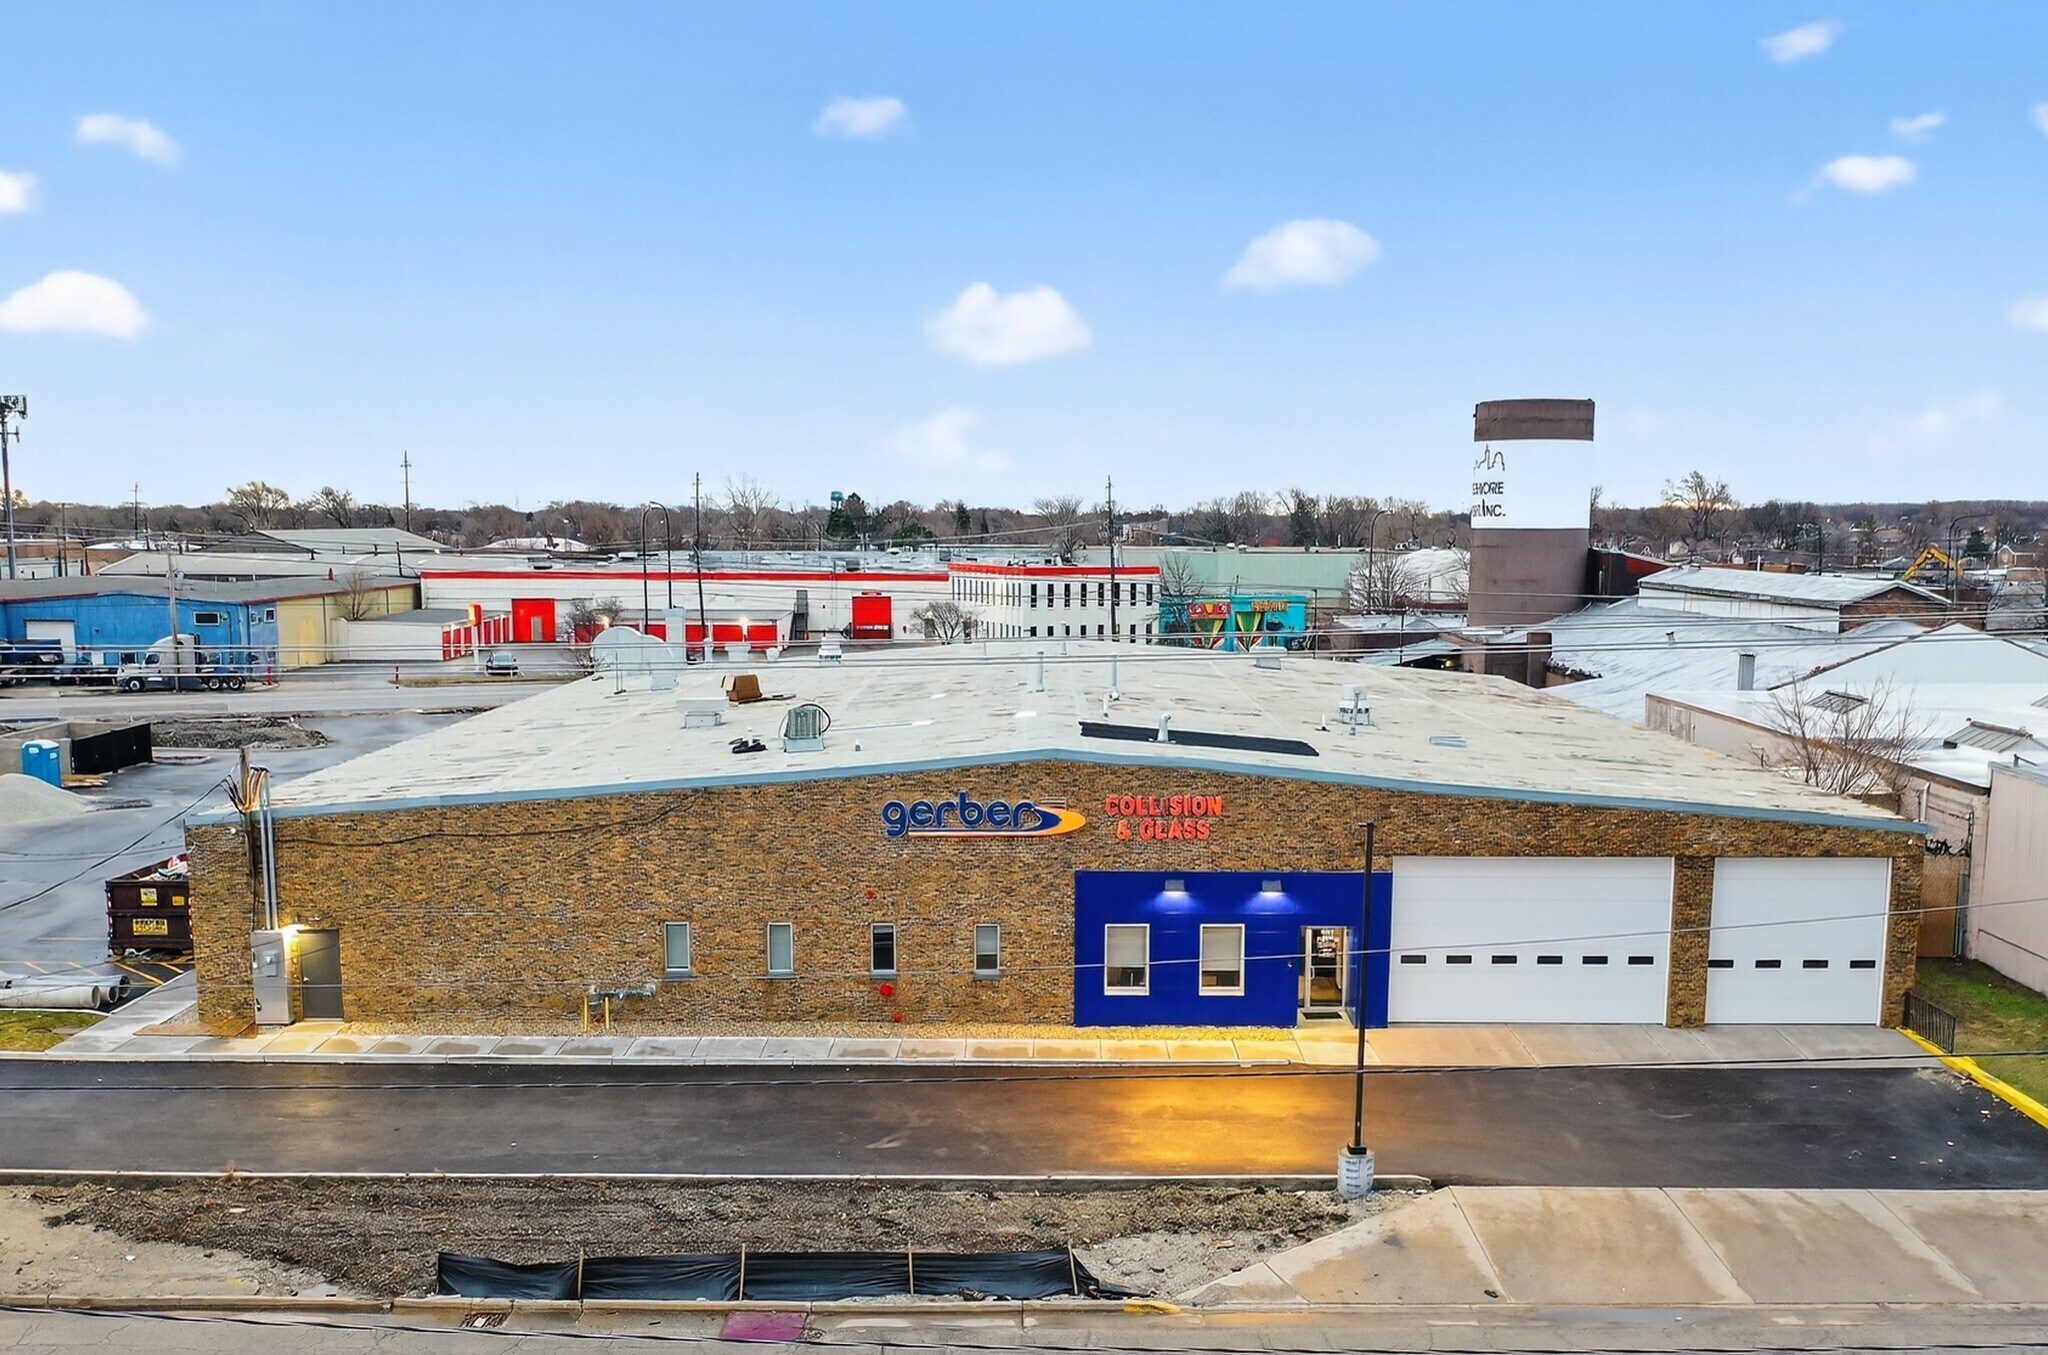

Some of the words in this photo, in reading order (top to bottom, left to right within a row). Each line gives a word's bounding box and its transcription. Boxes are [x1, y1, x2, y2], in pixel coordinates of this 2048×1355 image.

[881, 790, 1035, 838] gerber
[1105, 794, 1223, 816] COLLISION
[1116, 819, 1132, 840] &
[1139, 818, 1210, 840] GLASS
